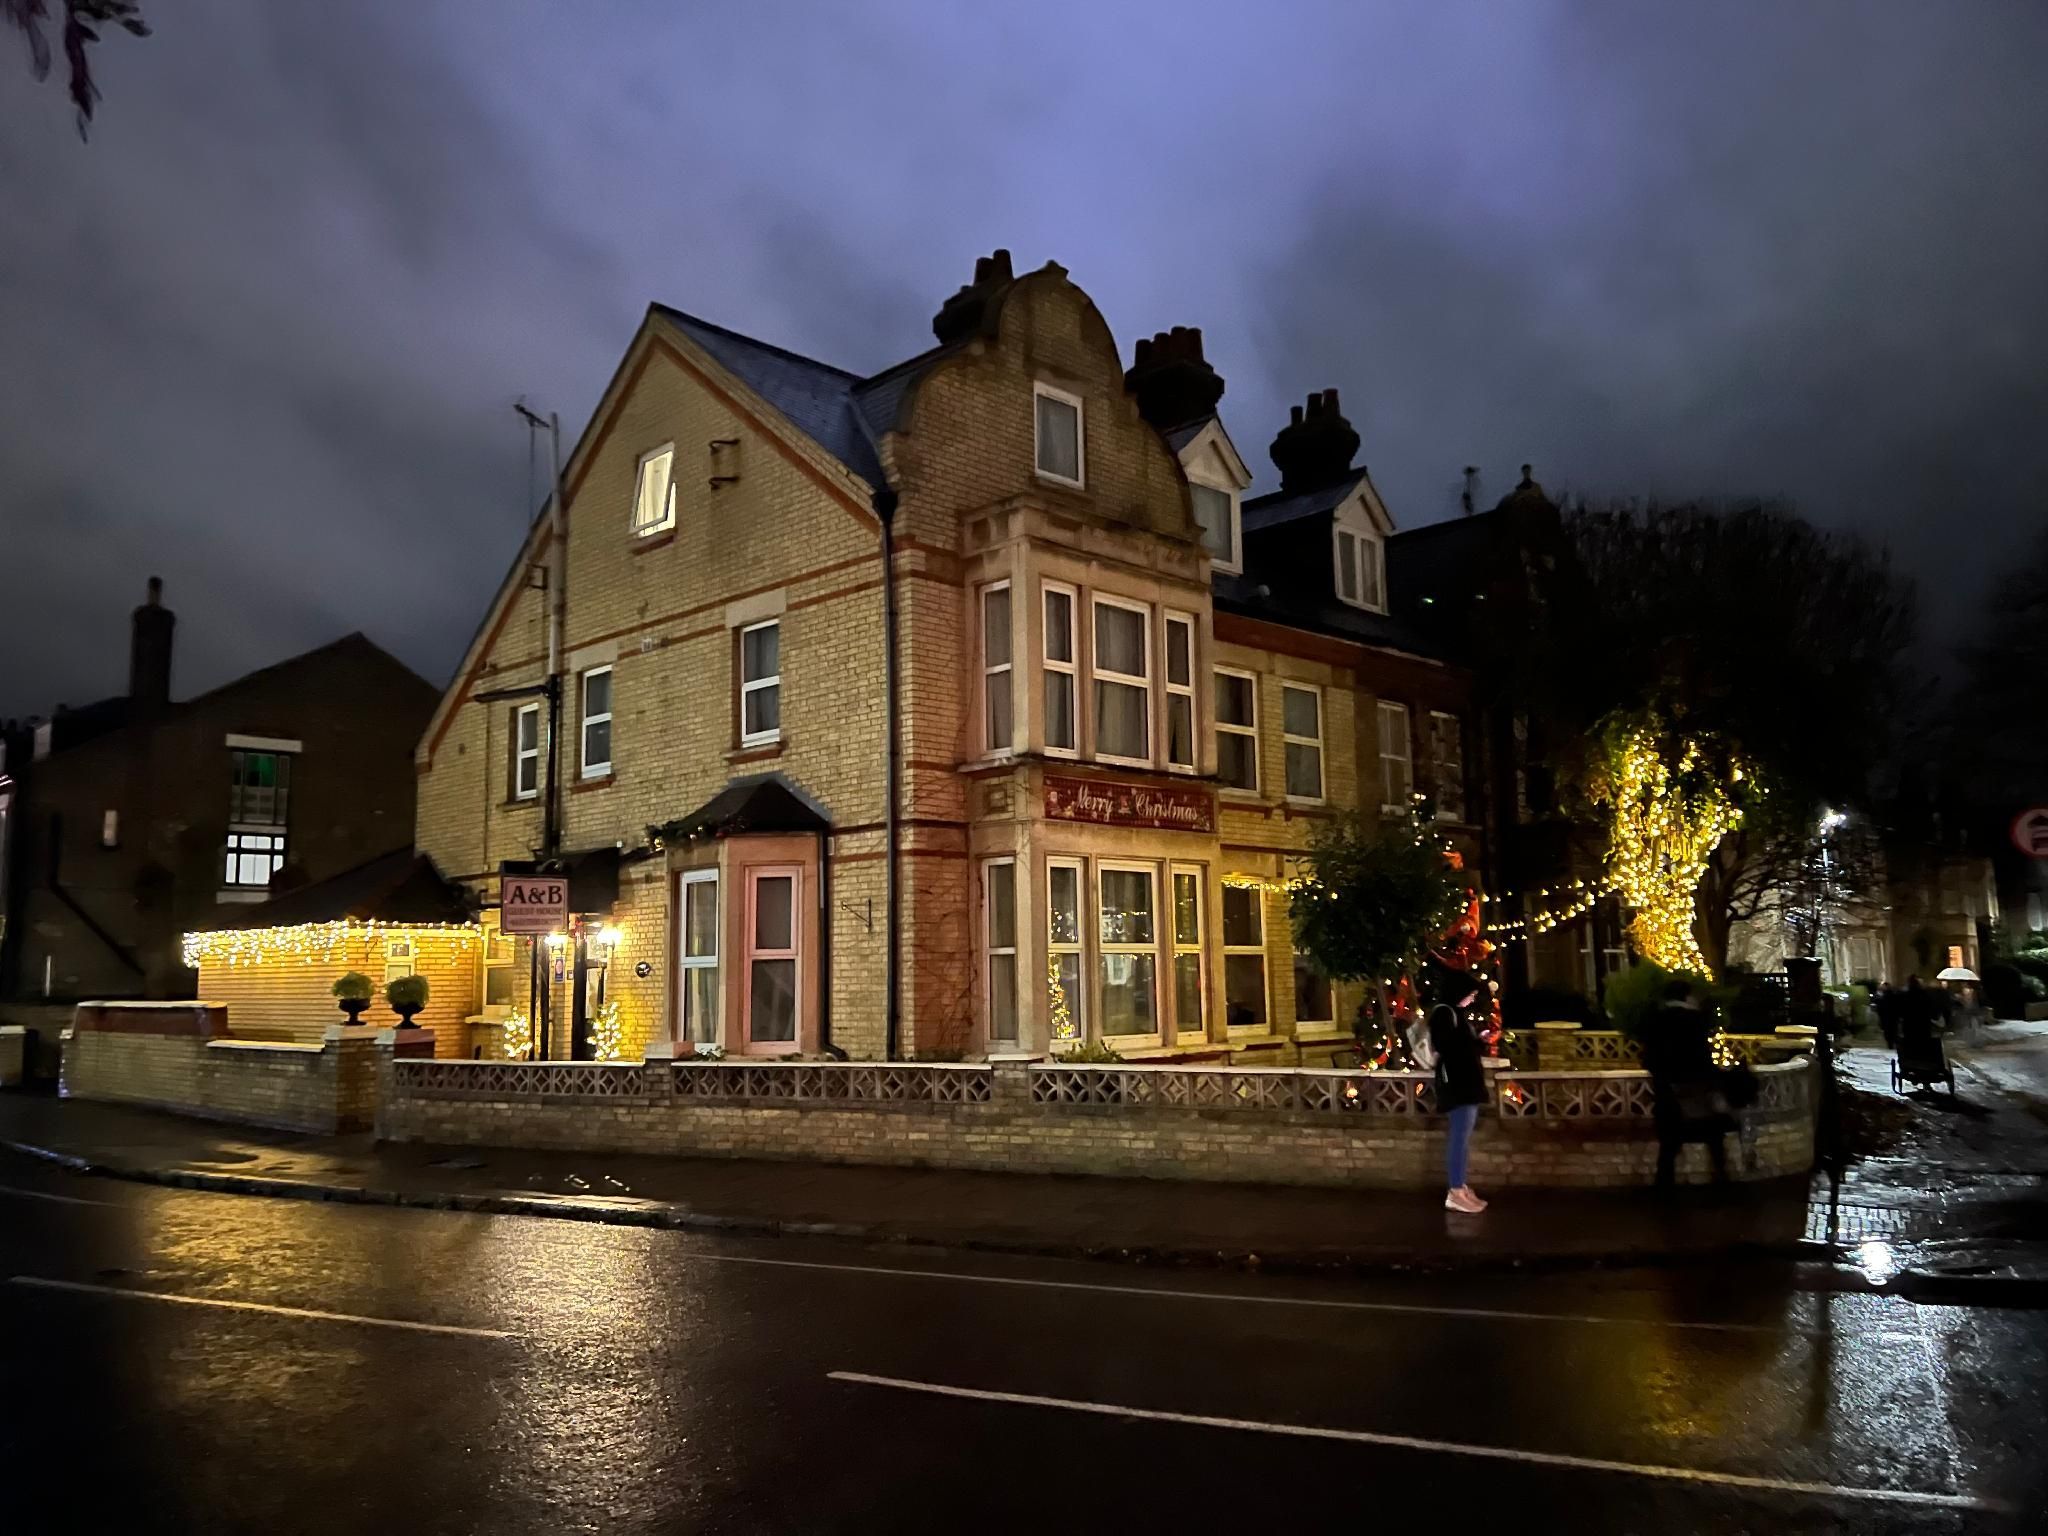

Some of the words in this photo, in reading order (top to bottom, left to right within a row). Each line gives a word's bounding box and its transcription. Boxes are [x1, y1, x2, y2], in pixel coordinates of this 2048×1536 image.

[1075, 784, 1113, 822] Merry
[1135, 792, 1199, 820] Christmas
[509, 885, 563, 905] A&B
